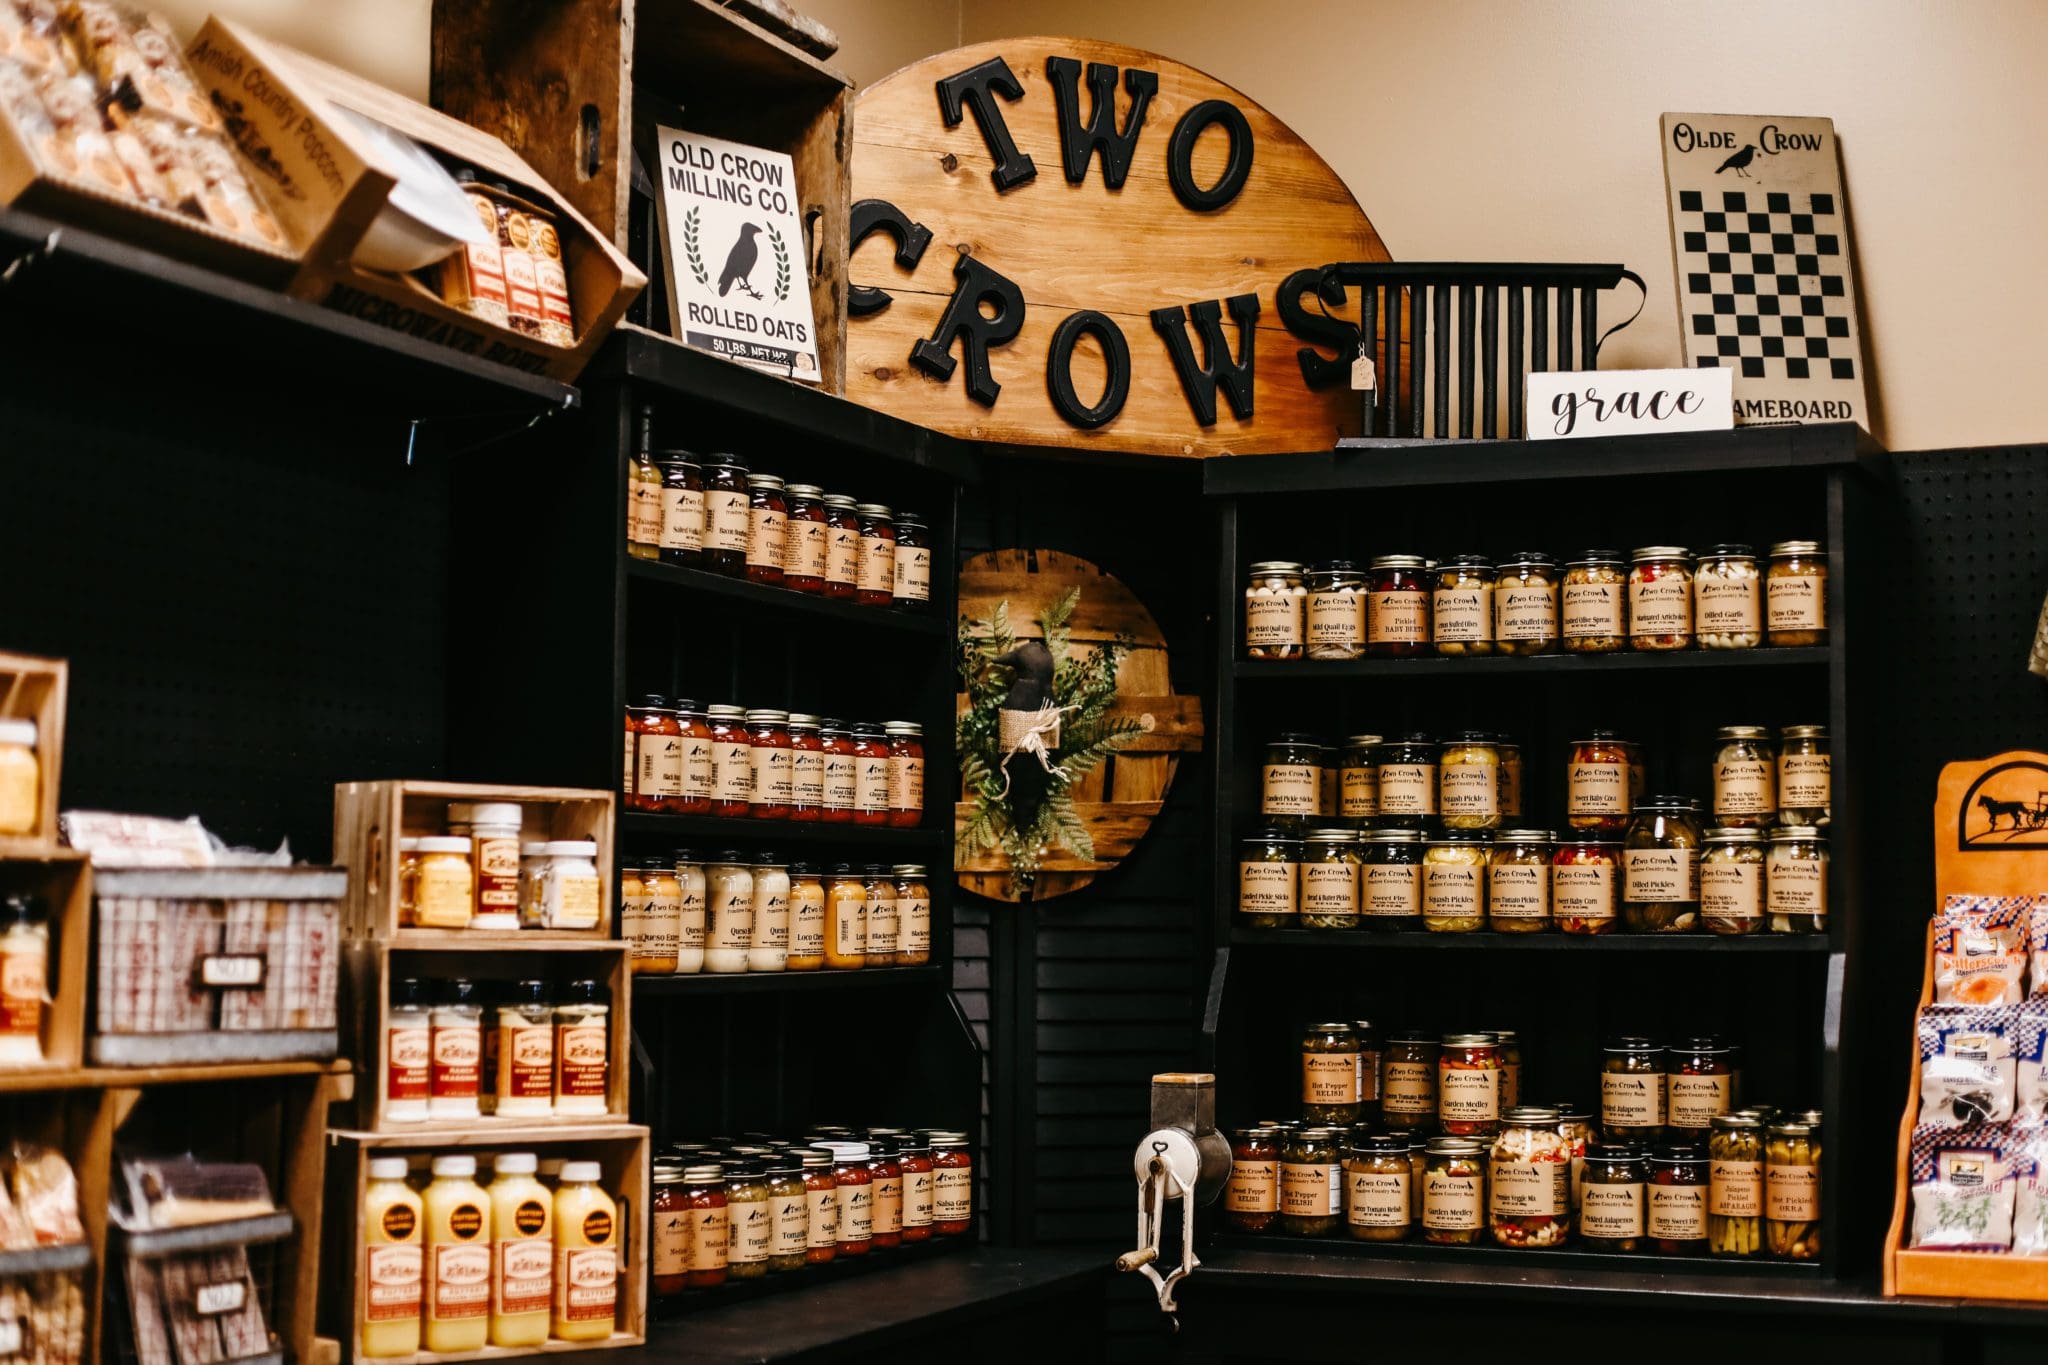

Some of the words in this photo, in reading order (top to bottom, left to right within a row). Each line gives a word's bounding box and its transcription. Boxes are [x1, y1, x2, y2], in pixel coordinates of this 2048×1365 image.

[935, 55, 1255, 212] TWO
[1672, 122, 1737, 153] OLDE
[1759, 125, 1822, 155] CROW
[672, 141, 714, 171] OLD
[721, 153, 783, 188] CROW
[668, 166, 753, 206] MILLING
[758, 187, 793, 217] CO.
[688, 302, 758, 333] ROLLED
[763, 317, 807, 343] OATS
[845, 197, 1368, 431] CROWS
[713, 338, 724, 352] 50
[750, 345, 770, 360] NET
[1552, 386, 1705, 436] grace
[1733, 399, 1852, 420] AMEBOARD
[1466, 1101, 1488, 1109] Medley
